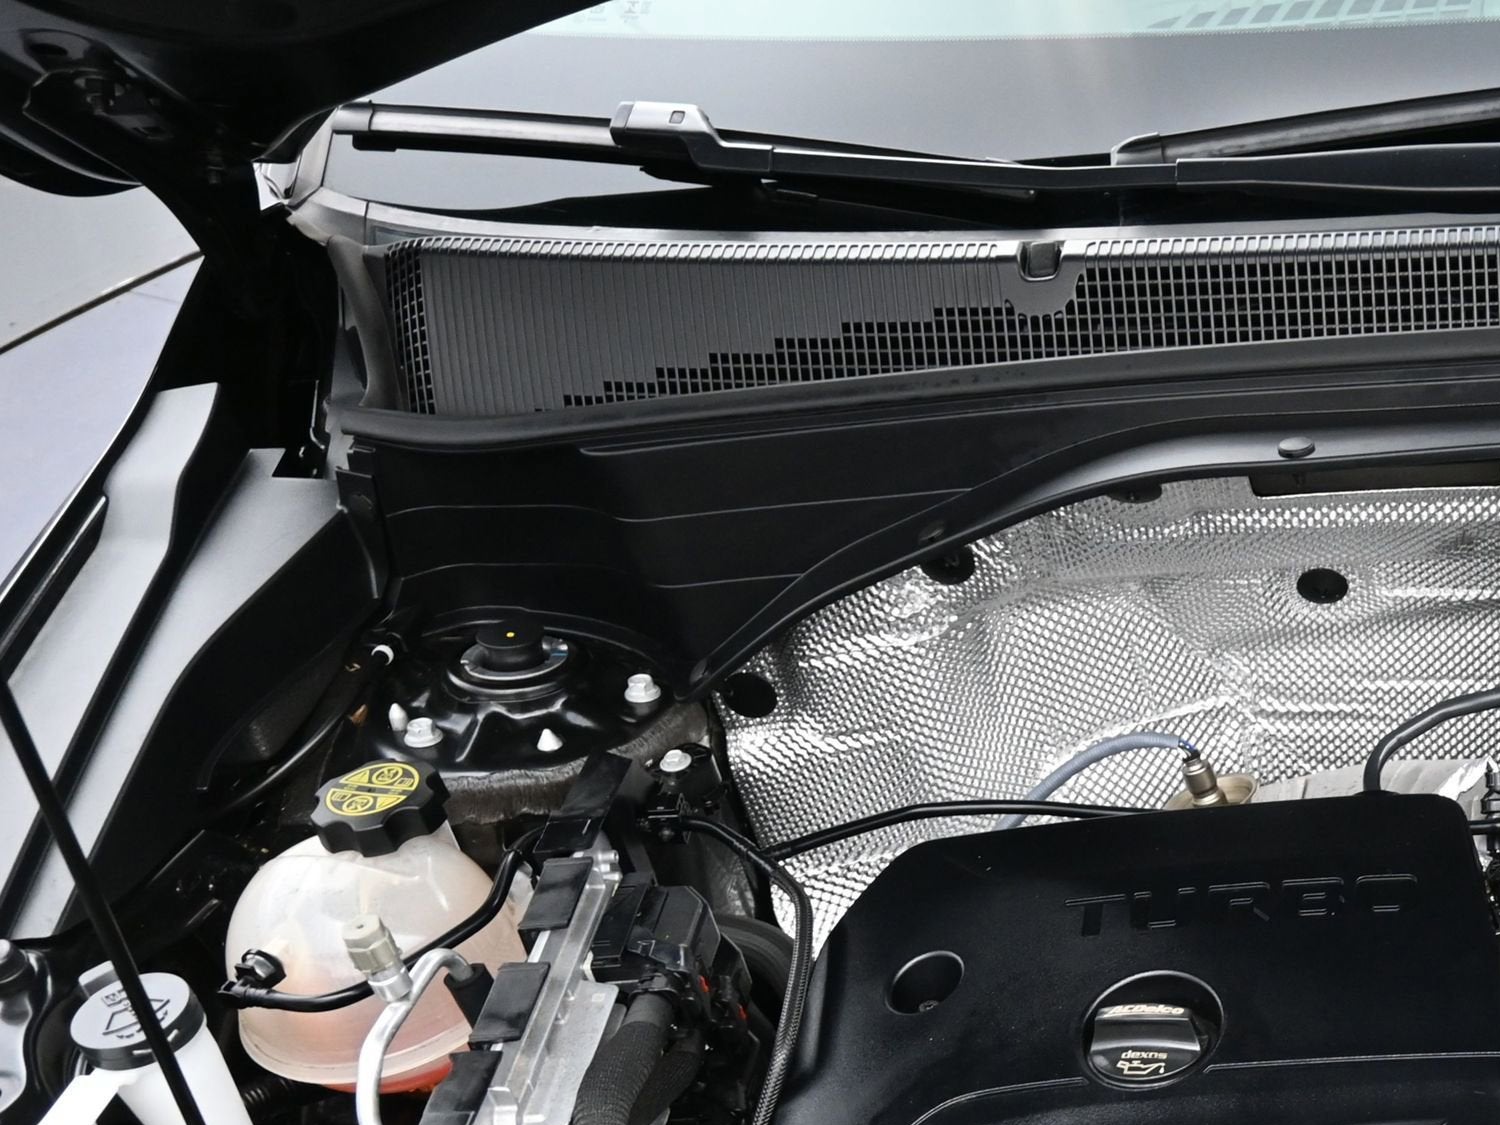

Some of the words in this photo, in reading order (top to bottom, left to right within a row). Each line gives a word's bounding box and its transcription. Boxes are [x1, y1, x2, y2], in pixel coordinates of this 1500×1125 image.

[1064, 873, 1418, 937] TURBO
[1103, 1003, 1185, 1017] ACDelco
[1121, 1049, 1169, 1060] dexos
